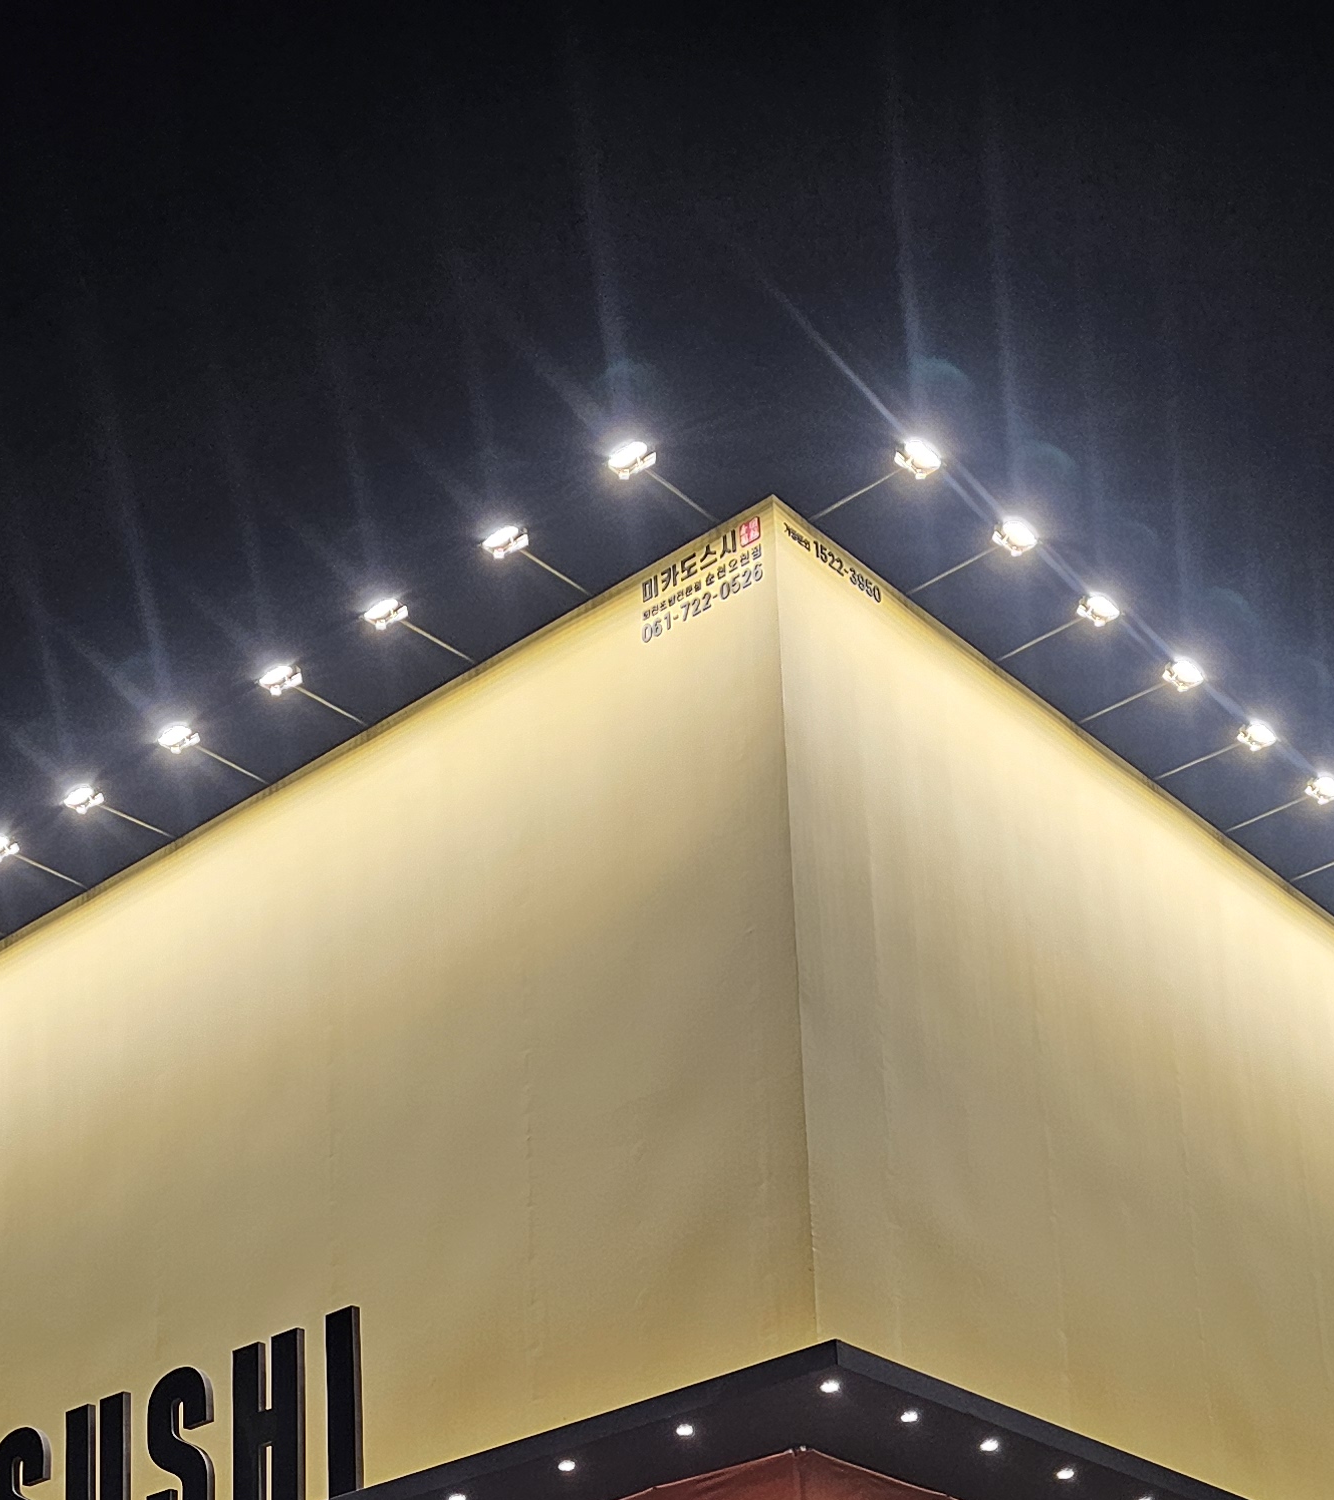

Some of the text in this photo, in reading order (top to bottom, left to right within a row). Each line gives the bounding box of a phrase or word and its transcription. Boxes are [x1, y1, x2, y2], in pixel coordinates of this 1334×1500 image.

[641, 529, 737, 604] 미카도스시
[705, 543, 763, 587] 순천오천점
[641, 562, 764, 644] 061-722-0526
